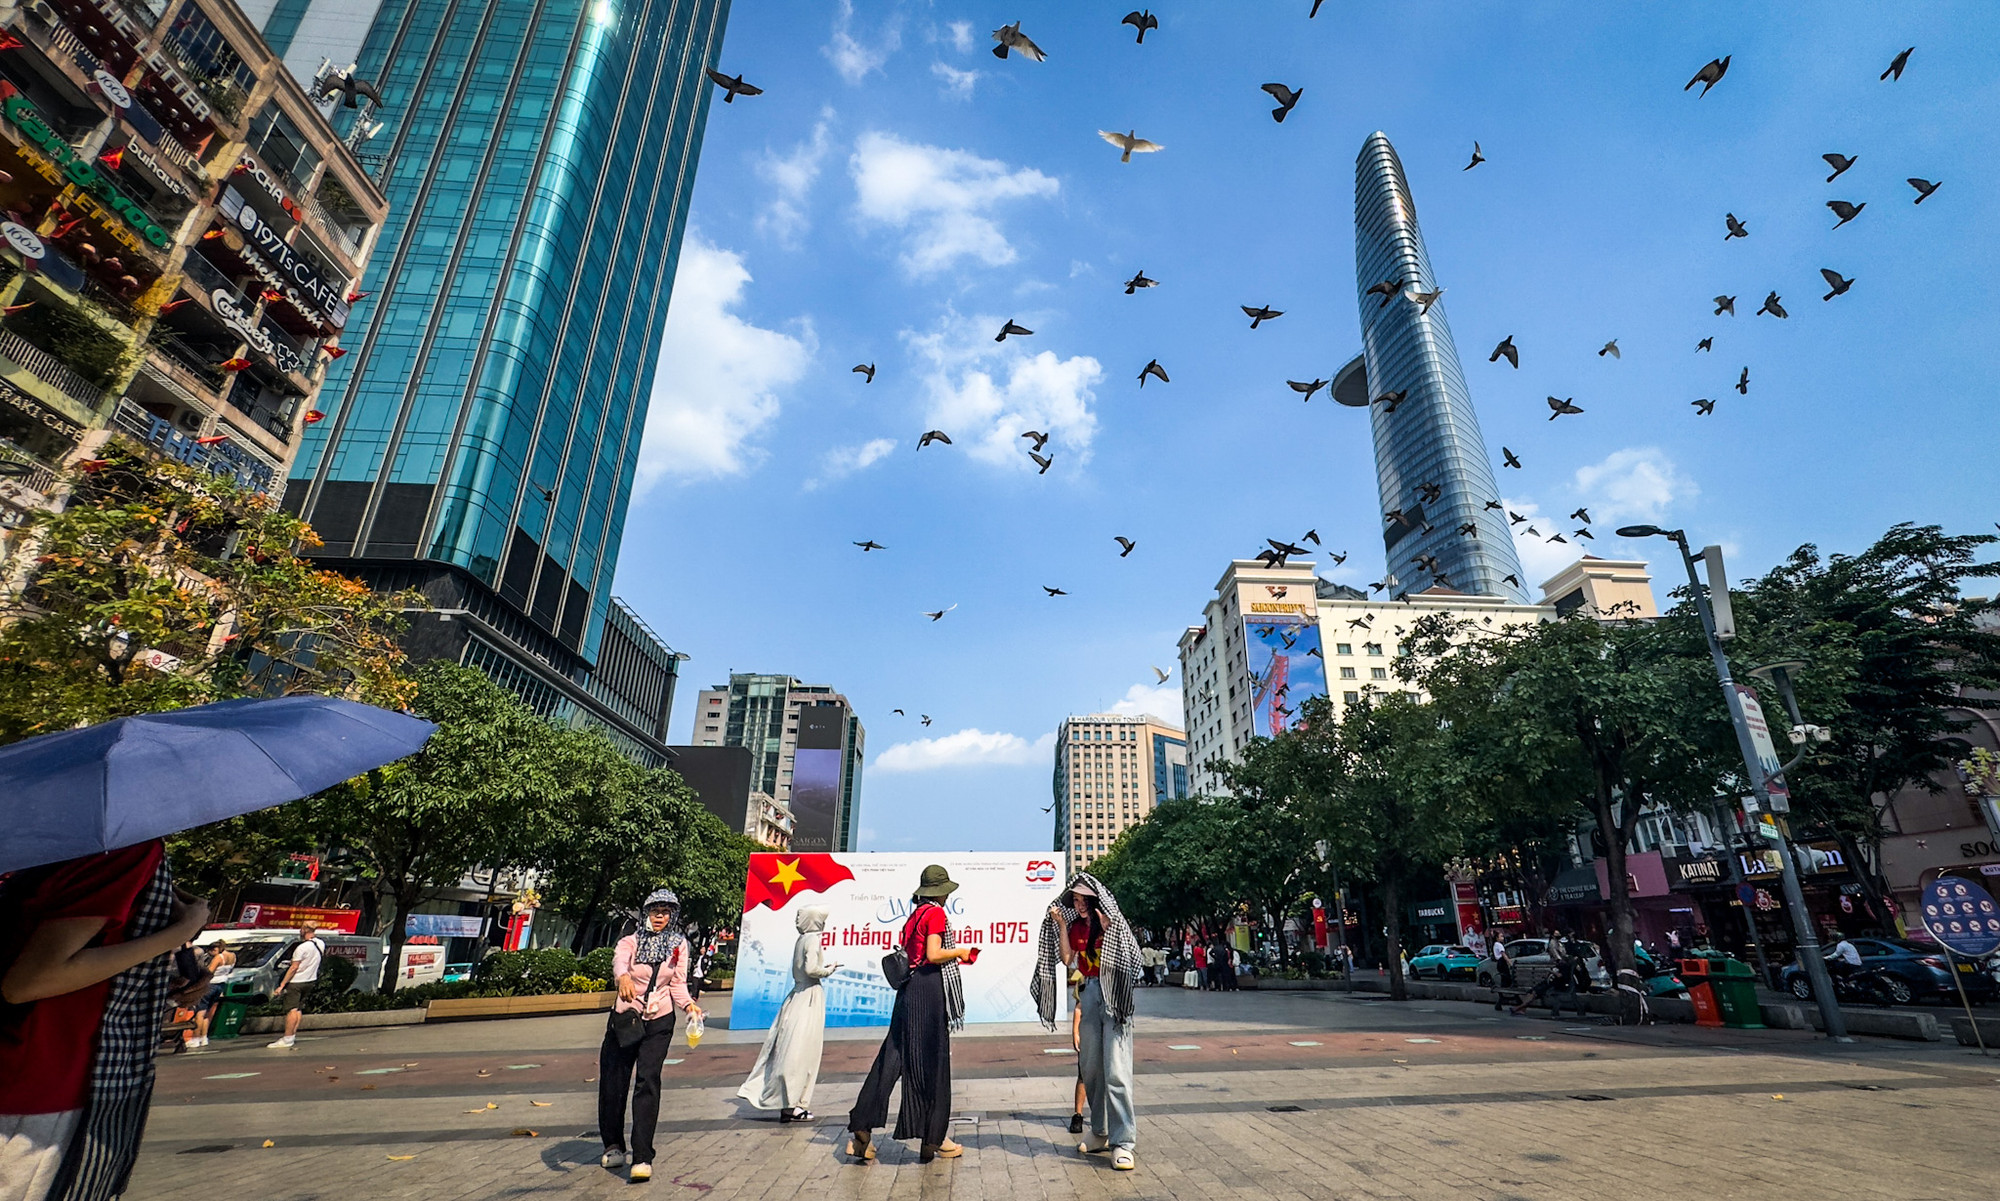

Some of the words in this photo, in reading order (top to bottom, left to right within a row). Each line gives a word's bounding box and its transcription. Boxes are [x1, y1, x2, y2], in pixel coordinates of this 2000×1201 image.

[97, 74, 130, 103] 1664
[127, 134, 181, 194] buihaus
[5, 226, 42, 254] 1664
[253, 219, 295, 271] 1971's
[293, 263, 338, 314] CAFE
[211, 288, 275, 354] Carlsberg
[285, 287, 325, 330] Sushi
[0, 384, 42, 419] RAKI
[1679, 860, 1721, 880] KATINAT
[1417, 907, 1445, 918] TARBUCKS
[821, 926, 837, 948] ại
[842, 922, 892, 950] thắng
[954, 925, 983, 944] uân
[990, 921, 1029, 944] 1975
